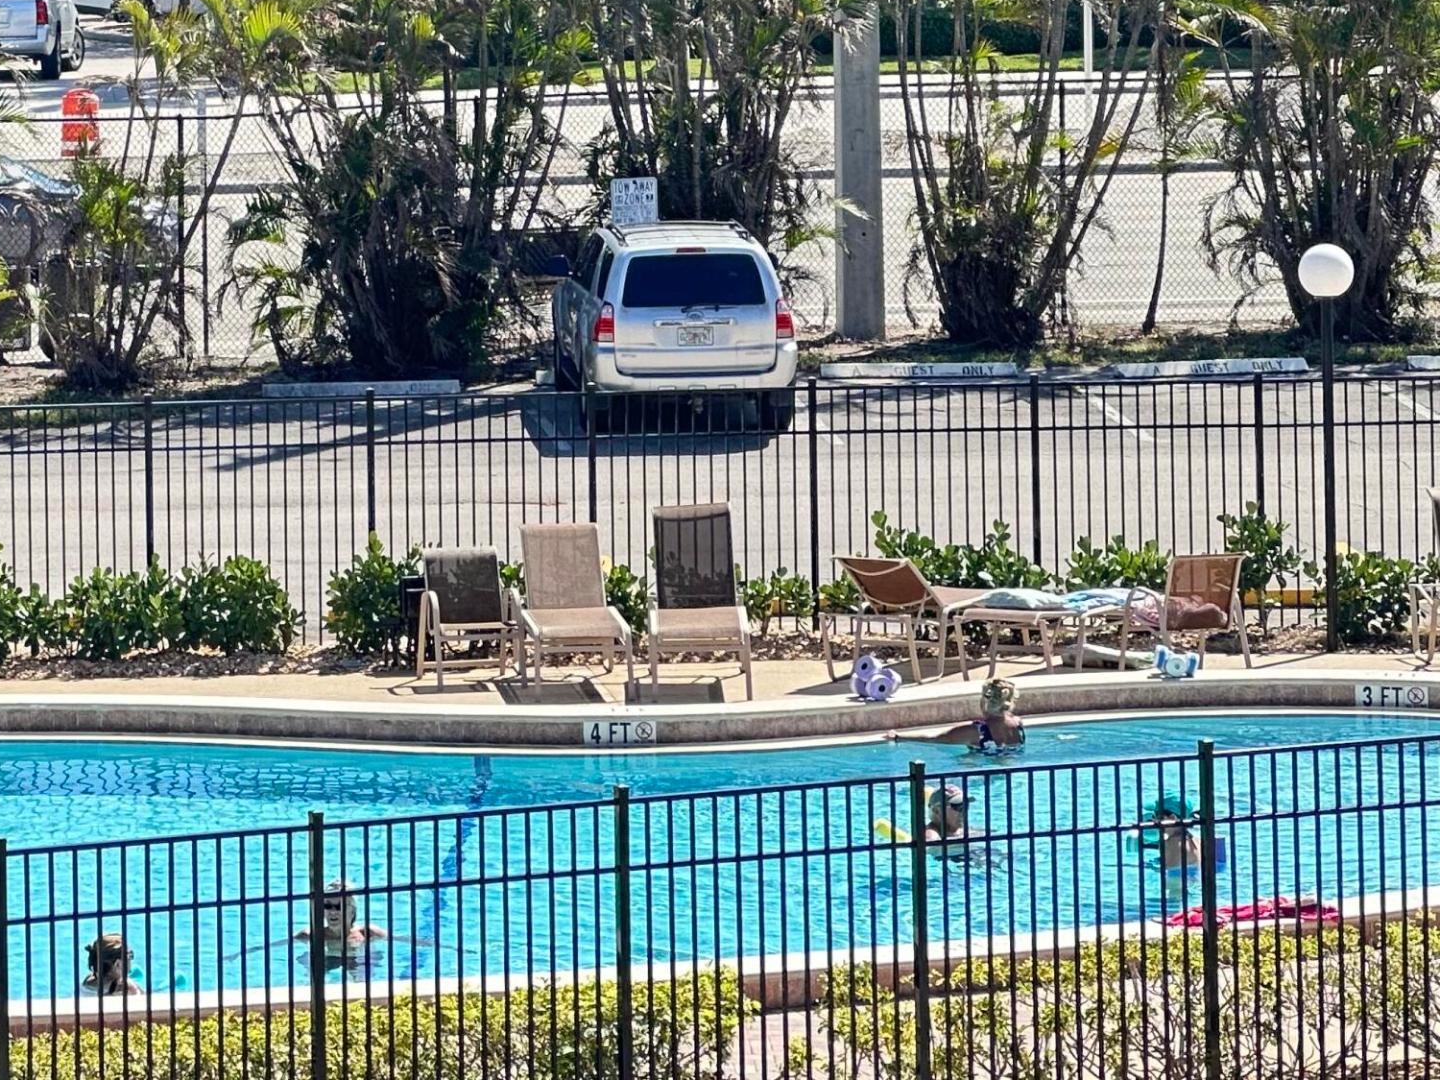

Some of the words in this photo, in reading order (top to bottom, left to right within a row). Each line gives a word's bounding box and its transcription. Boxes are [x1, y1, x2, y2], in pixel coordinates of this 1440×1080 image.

[962, 365, 994, 376] ONLY
[1252, 360, 1283, 371] ONLY
[1363, 686, 1372, 707] 3
[1381, 686, 1403, 707] FT
[591, 723, 601, 744] 4
[609, 723, 631, 744] FT
